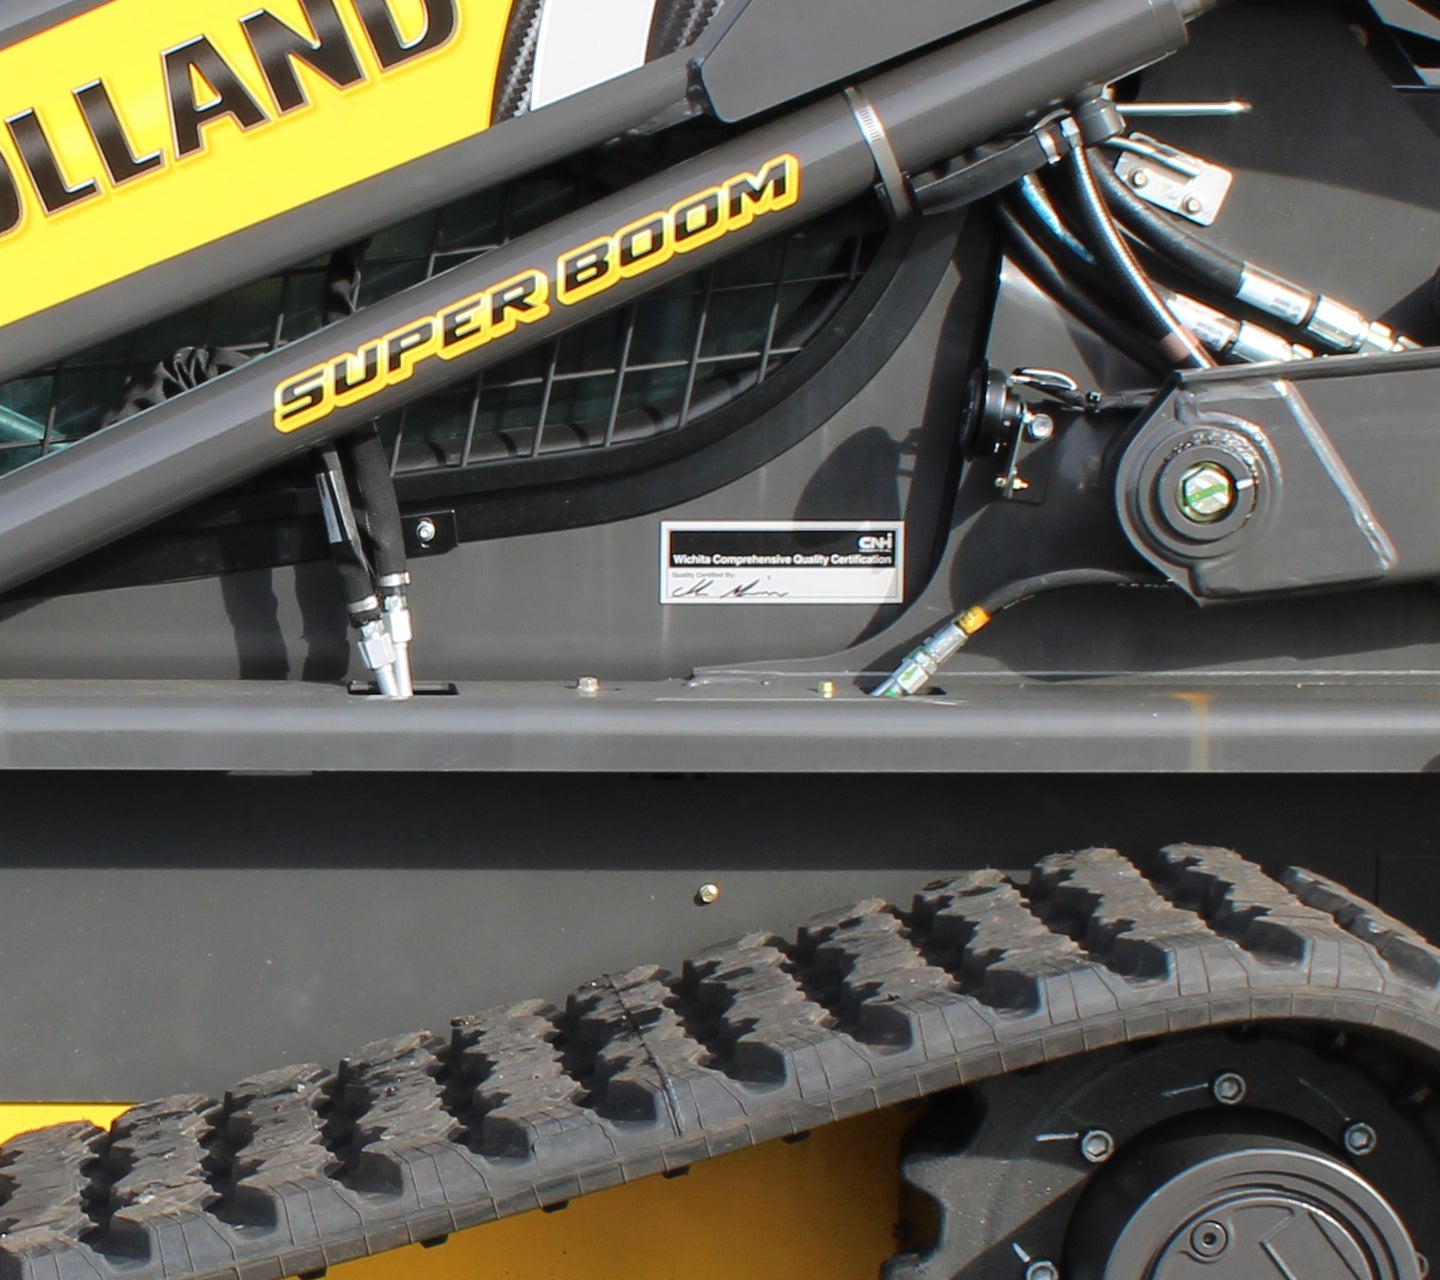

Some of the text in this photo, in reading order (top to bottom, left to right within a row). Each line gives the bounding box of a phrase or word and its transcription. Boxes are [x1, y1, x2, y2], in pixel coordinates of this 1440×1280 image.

[275, 154, 800, 432] SUPER BOOM
[673, 554, 892, 566] Wichita Comprehensive Quality Certification
[671, 571, 694, 579] Quality
